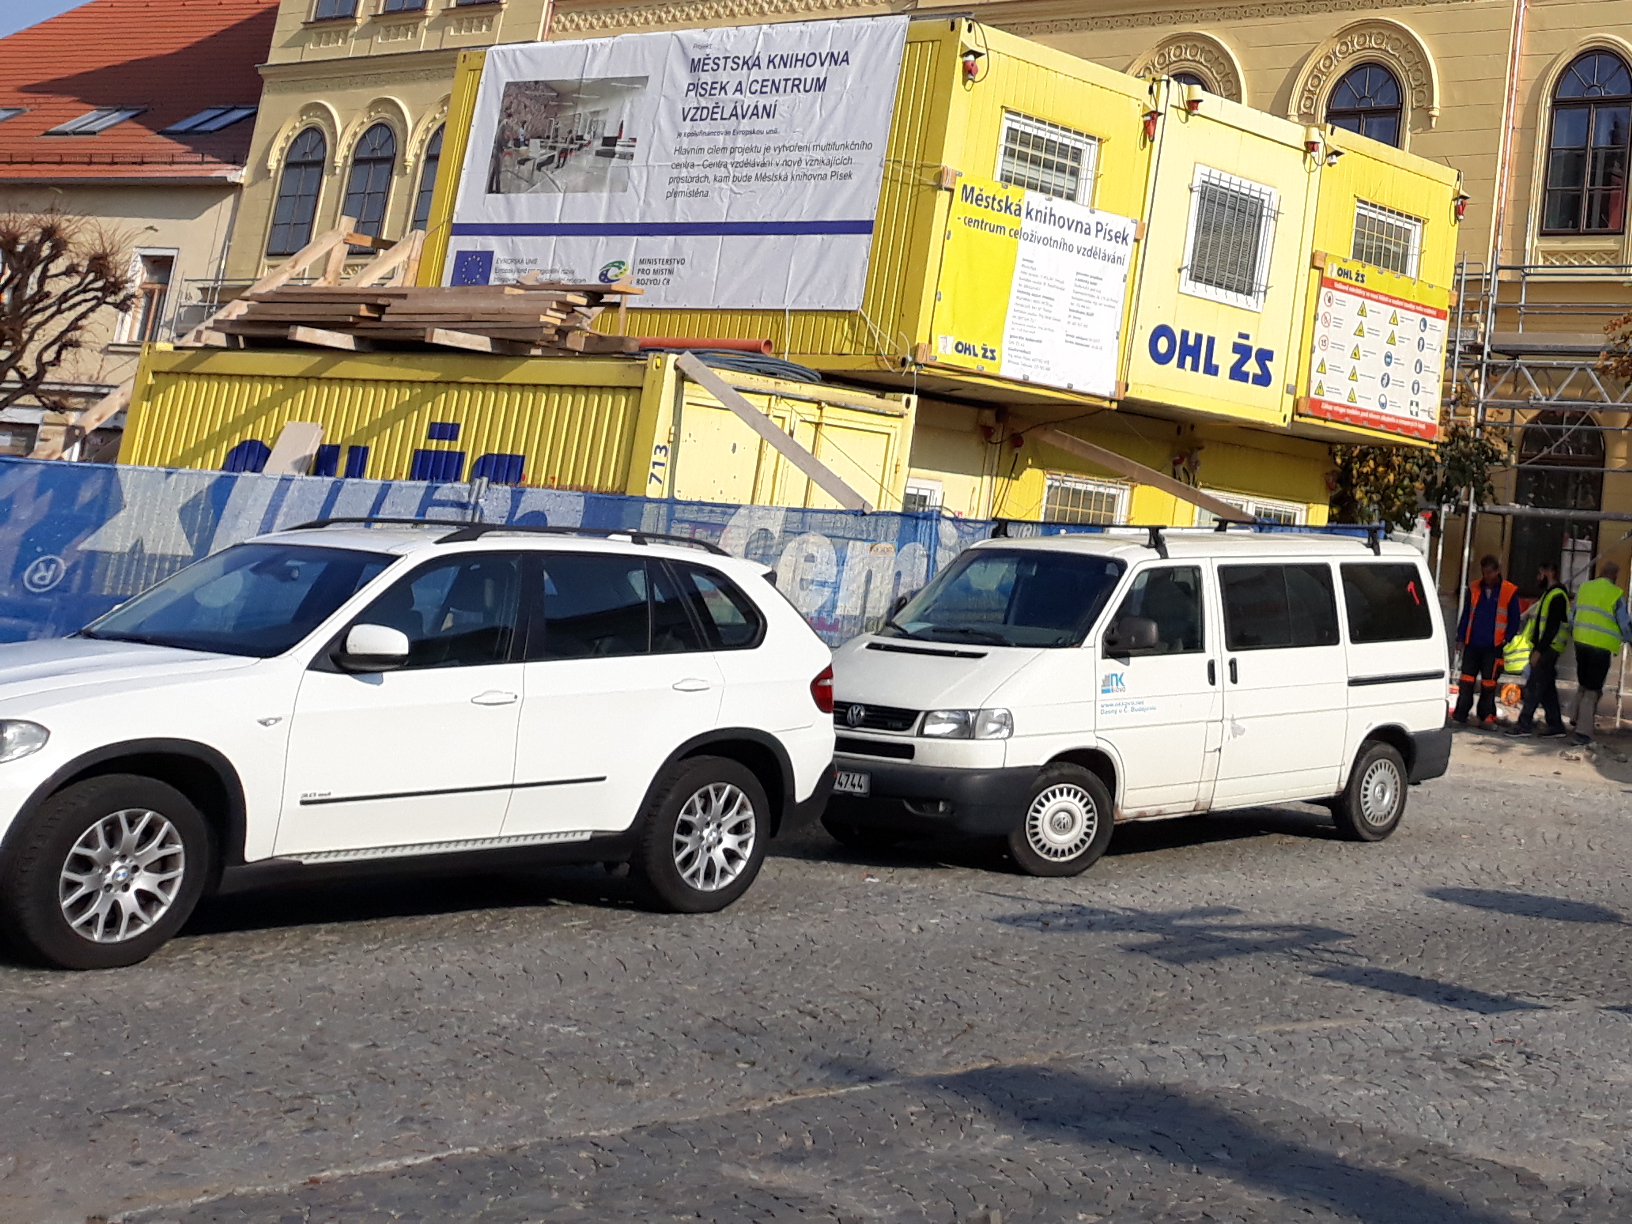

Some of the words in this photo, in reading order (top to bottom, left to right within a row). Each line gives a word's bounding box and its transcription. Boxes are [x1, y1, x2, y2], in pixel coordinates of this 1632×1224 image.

[689, 50, 762, 74] MĚSTSKÁ
[766, 50, 851, 70] KNIHOVNA
[685, 77, 731, 98] PÍSEK
[732, 79, 744, 96] A
[748, 76, 828, 96] CENTRUM
[681, 99, 778, 122] VZDĚLÁVÁNÍ
[673, 145, 705, 156] Hlavním
[706, 144, 728, 155] cílem
[729, 143, 762, 157] projektu
[763, 143, 771, 156] je
[773, 142, 811, 155] vytvoření
[804, 155, 853, 168] vznikajících
[712, 172, 731, 183] kam
[732, 171, 753, 183] bude
[790, 169, 828, 182] knihovna
[829, 169, 853, 181] Písek
[960, 183, 1023, 218] Městská
[1025, 201, 1092, 237] knihovna
[1094, 220, 1130, 247] Písek
[963, 215, 1006, 236] centrum
[1008, 225, 1075, 253] celoživotního
[1076, 243, 1127, 267] vzdělávání
[637, 267, 651, 276] PRO
[638, 257, 686, 266] MINISTERSTVO
[636, 278, 662, 287] ROZVOJ
[1336, 266, 1353, 281] OHL
[1354, 269, 1366, 284] ŽS
[954, 340, 979, 359] OHL
[980, 342, 997, 361] ŽS
[1148, 323, 1220, 377] OHL
[1228, 331, 1274, 388] ŽS
[648, 444, 669, 485] 713
[836, 772, 863, 791] 4744
